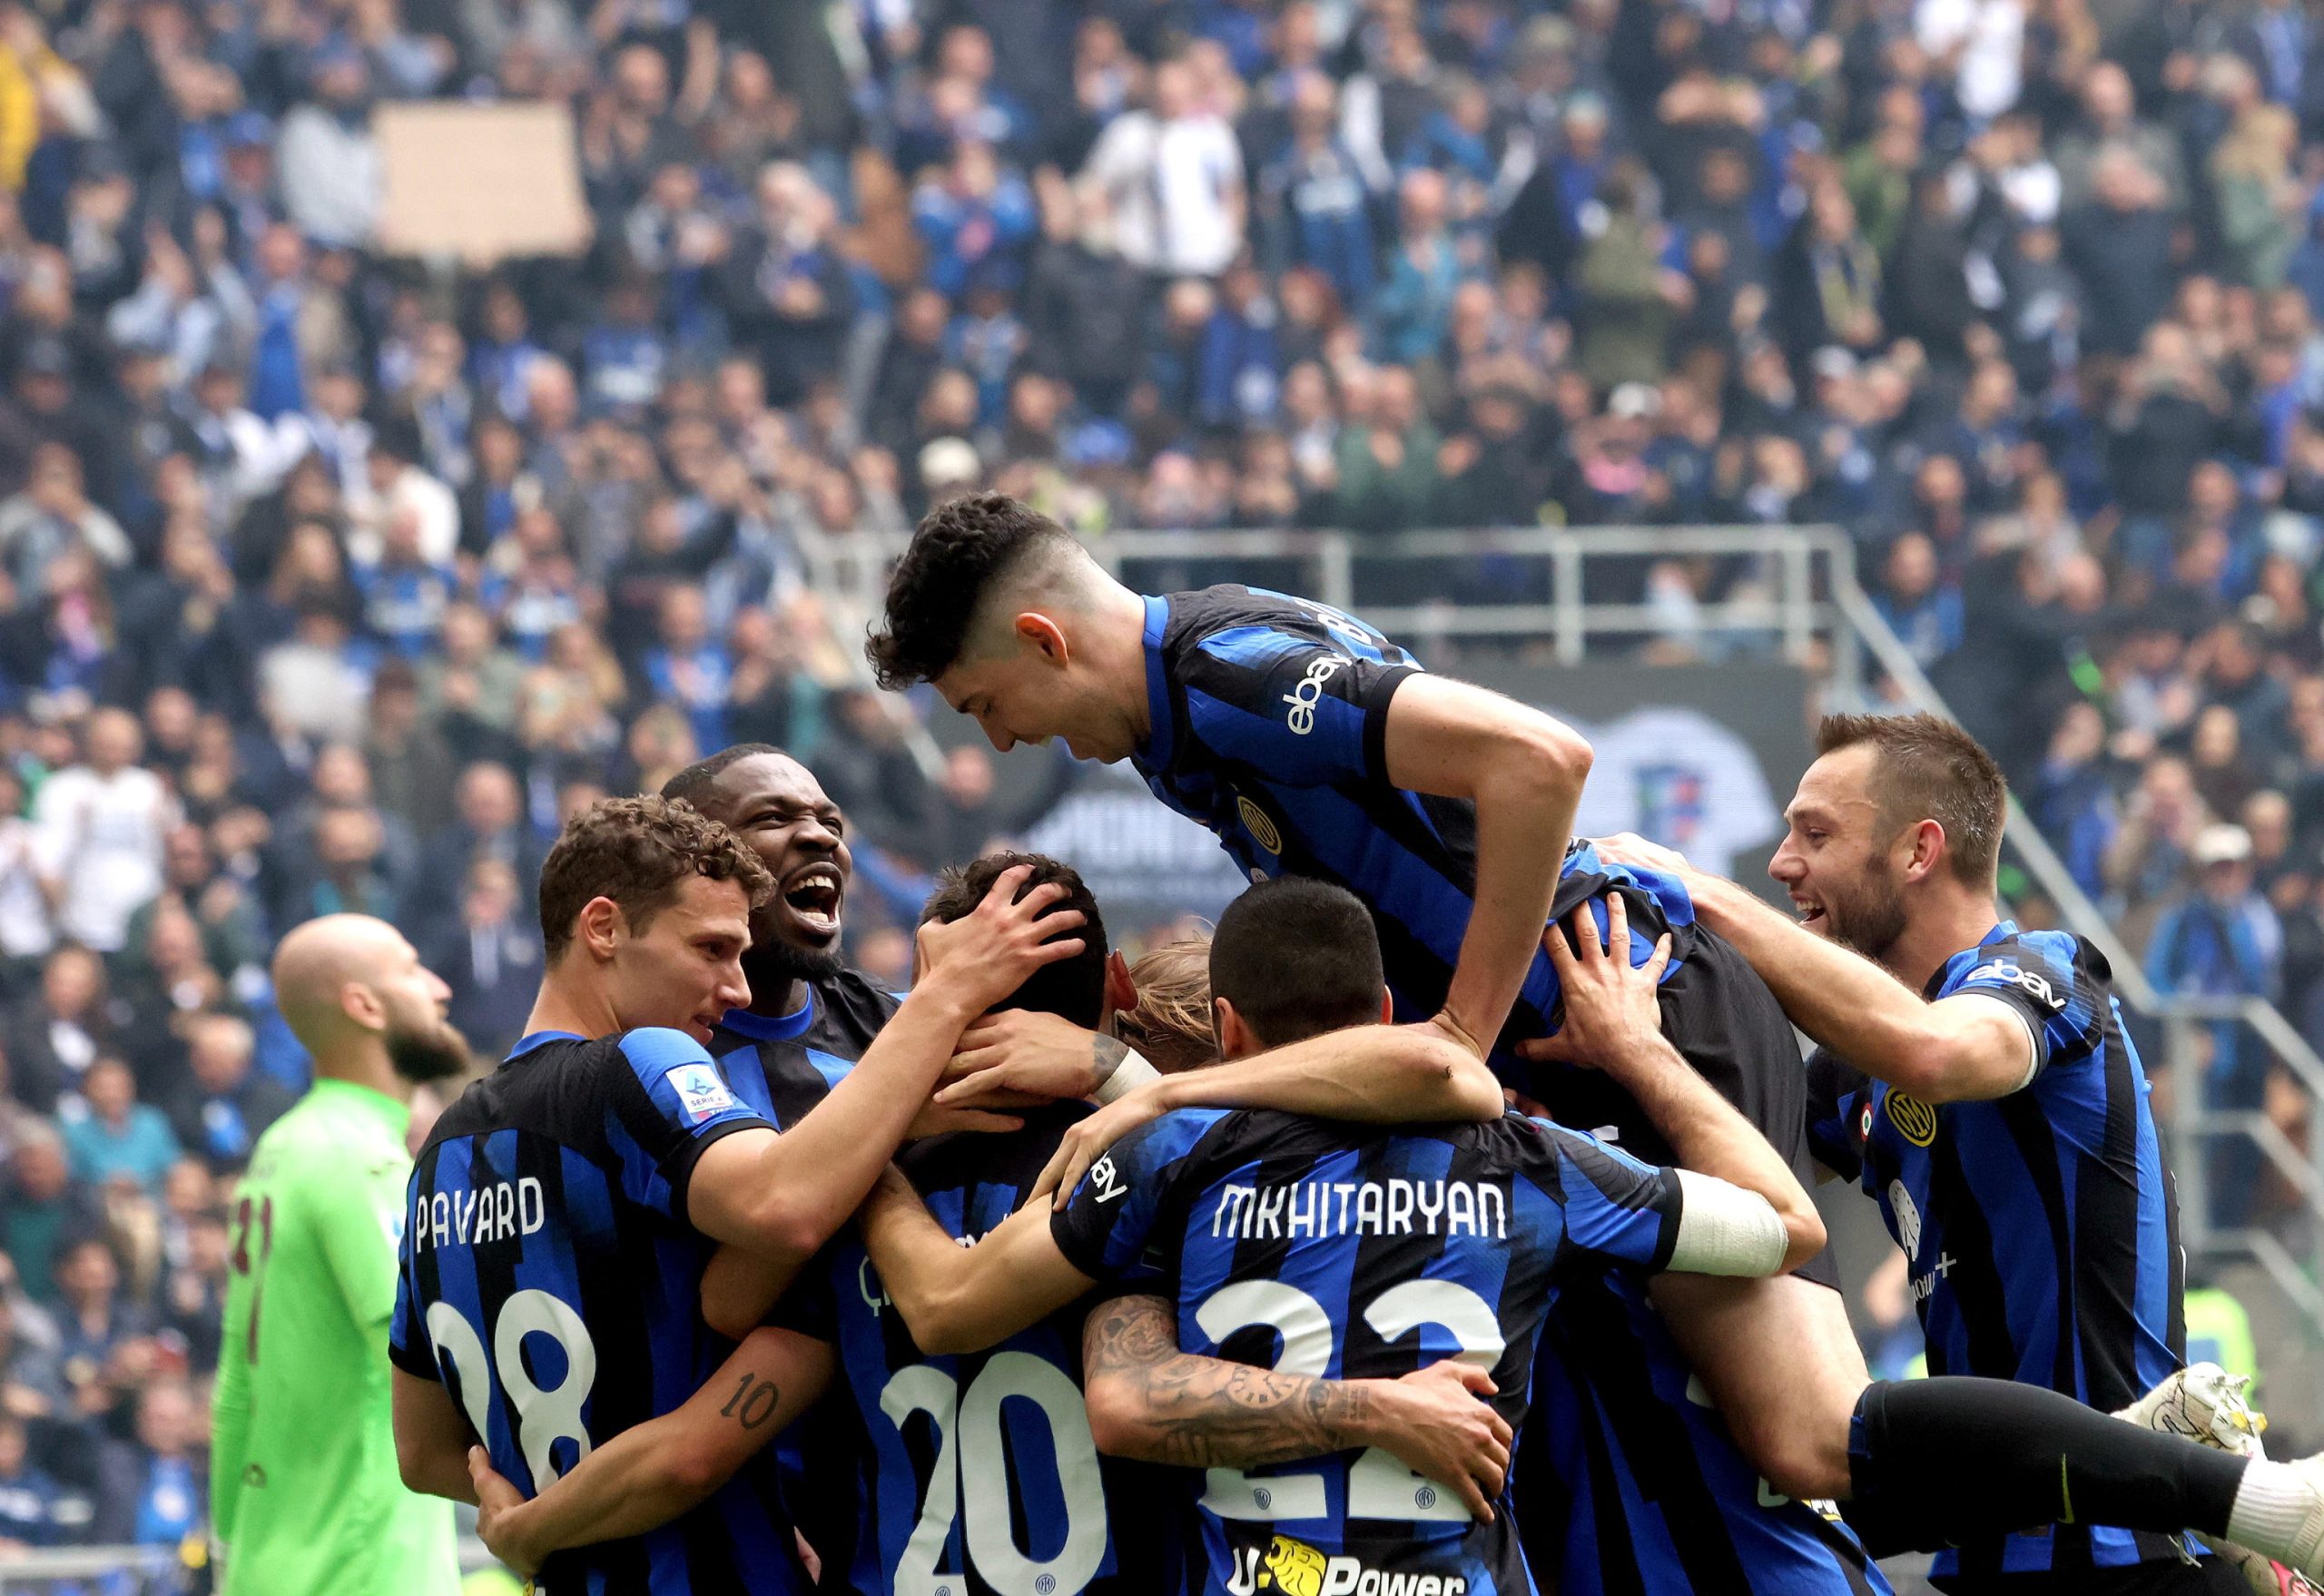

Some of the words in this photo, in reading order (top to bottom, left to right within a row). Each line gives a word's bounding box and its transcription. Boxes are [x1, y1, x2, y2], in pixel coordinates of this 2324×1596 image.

[1282, 652, 1353, 735] ebay
[415, 1176, 545, 1254] PAVARD
[1090, 1149, 1128, 1204] ay
[1211, 1178, 1508, 1239] MKHITARYAN
[720, 1372, 780, 1430] 10
[1195, 1278, 1508, 1522] 22
[879, 1350, 1108, 1596] 20
